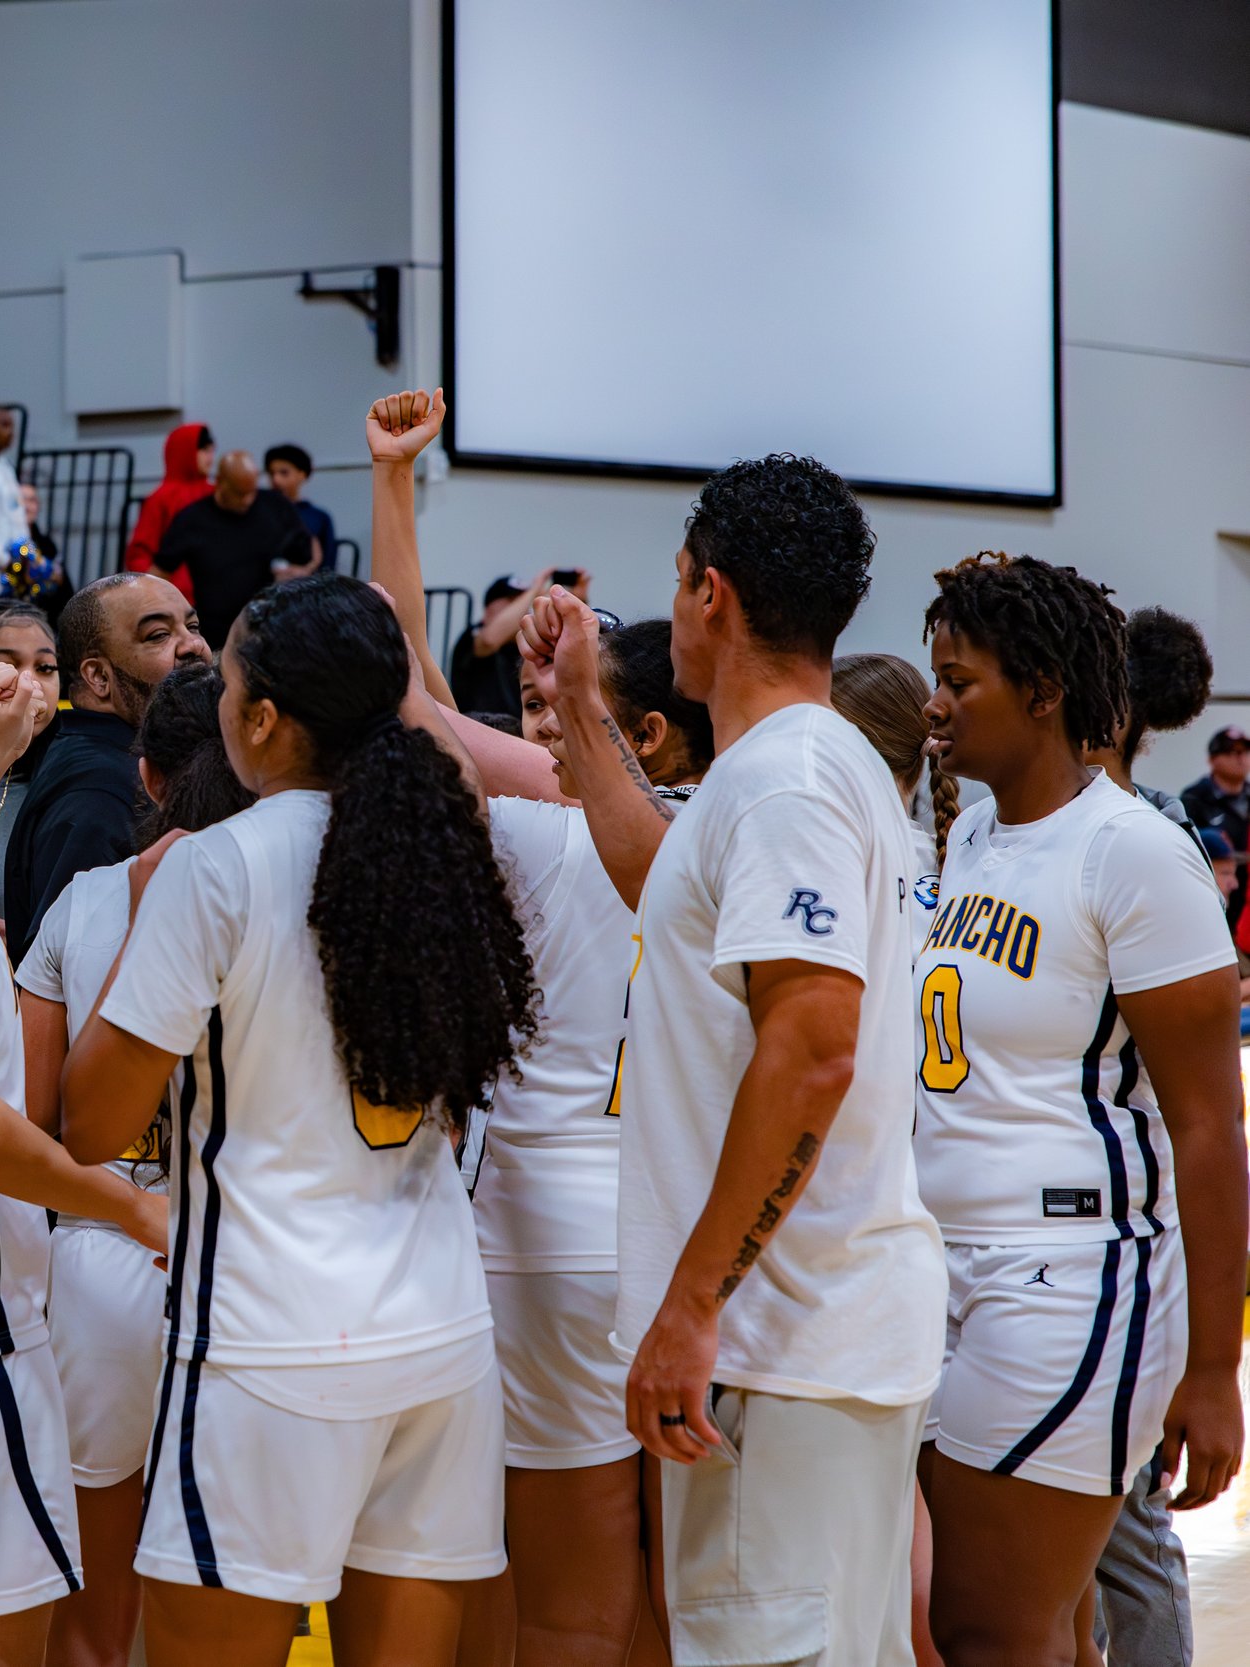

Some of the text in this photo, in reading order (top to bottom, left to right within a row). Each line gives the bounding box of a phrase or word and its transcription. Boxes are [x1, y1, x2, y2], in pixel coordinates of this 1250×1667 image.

[781, 887, 839, 938] RC
[920, 893, 1042, 982] ANCHO
[919, 963, 971, 1094] 0
[1083, 1197, 1095, 1209] M
